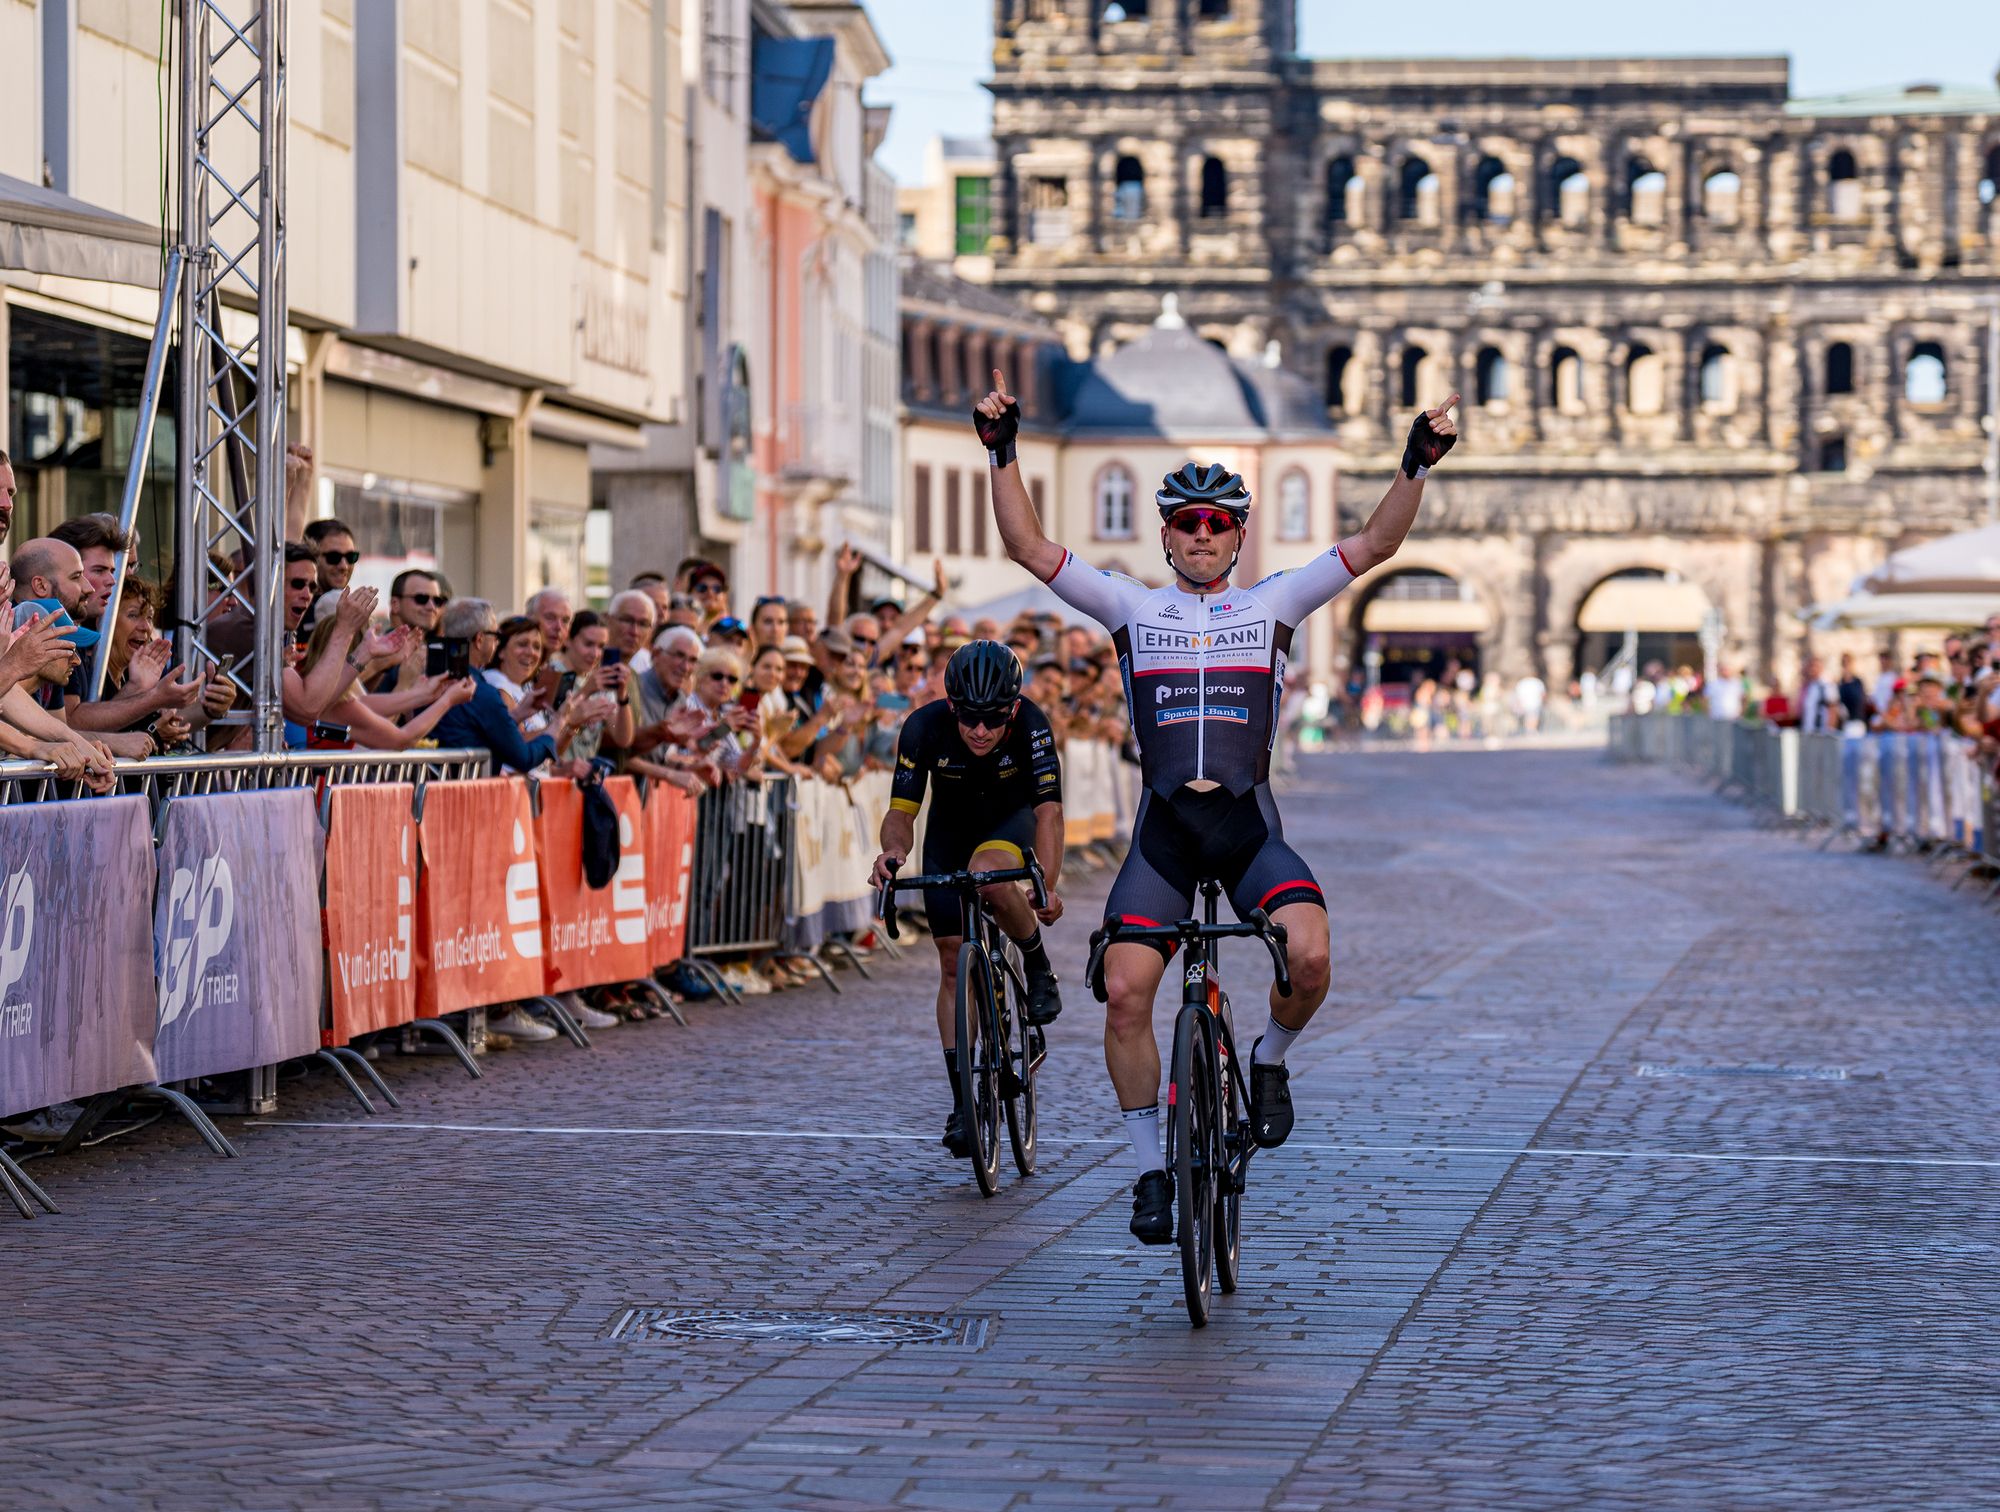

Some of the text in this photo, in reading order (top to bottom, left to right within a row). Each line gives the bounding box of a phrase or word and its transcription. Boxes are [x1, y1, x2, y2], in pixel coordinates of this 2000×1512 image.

[1146, 628, 1258, 649] EHRMANN
[207, 974, 239, 1006] TRIER
[5, 1002, 33, 1039] TRIER
